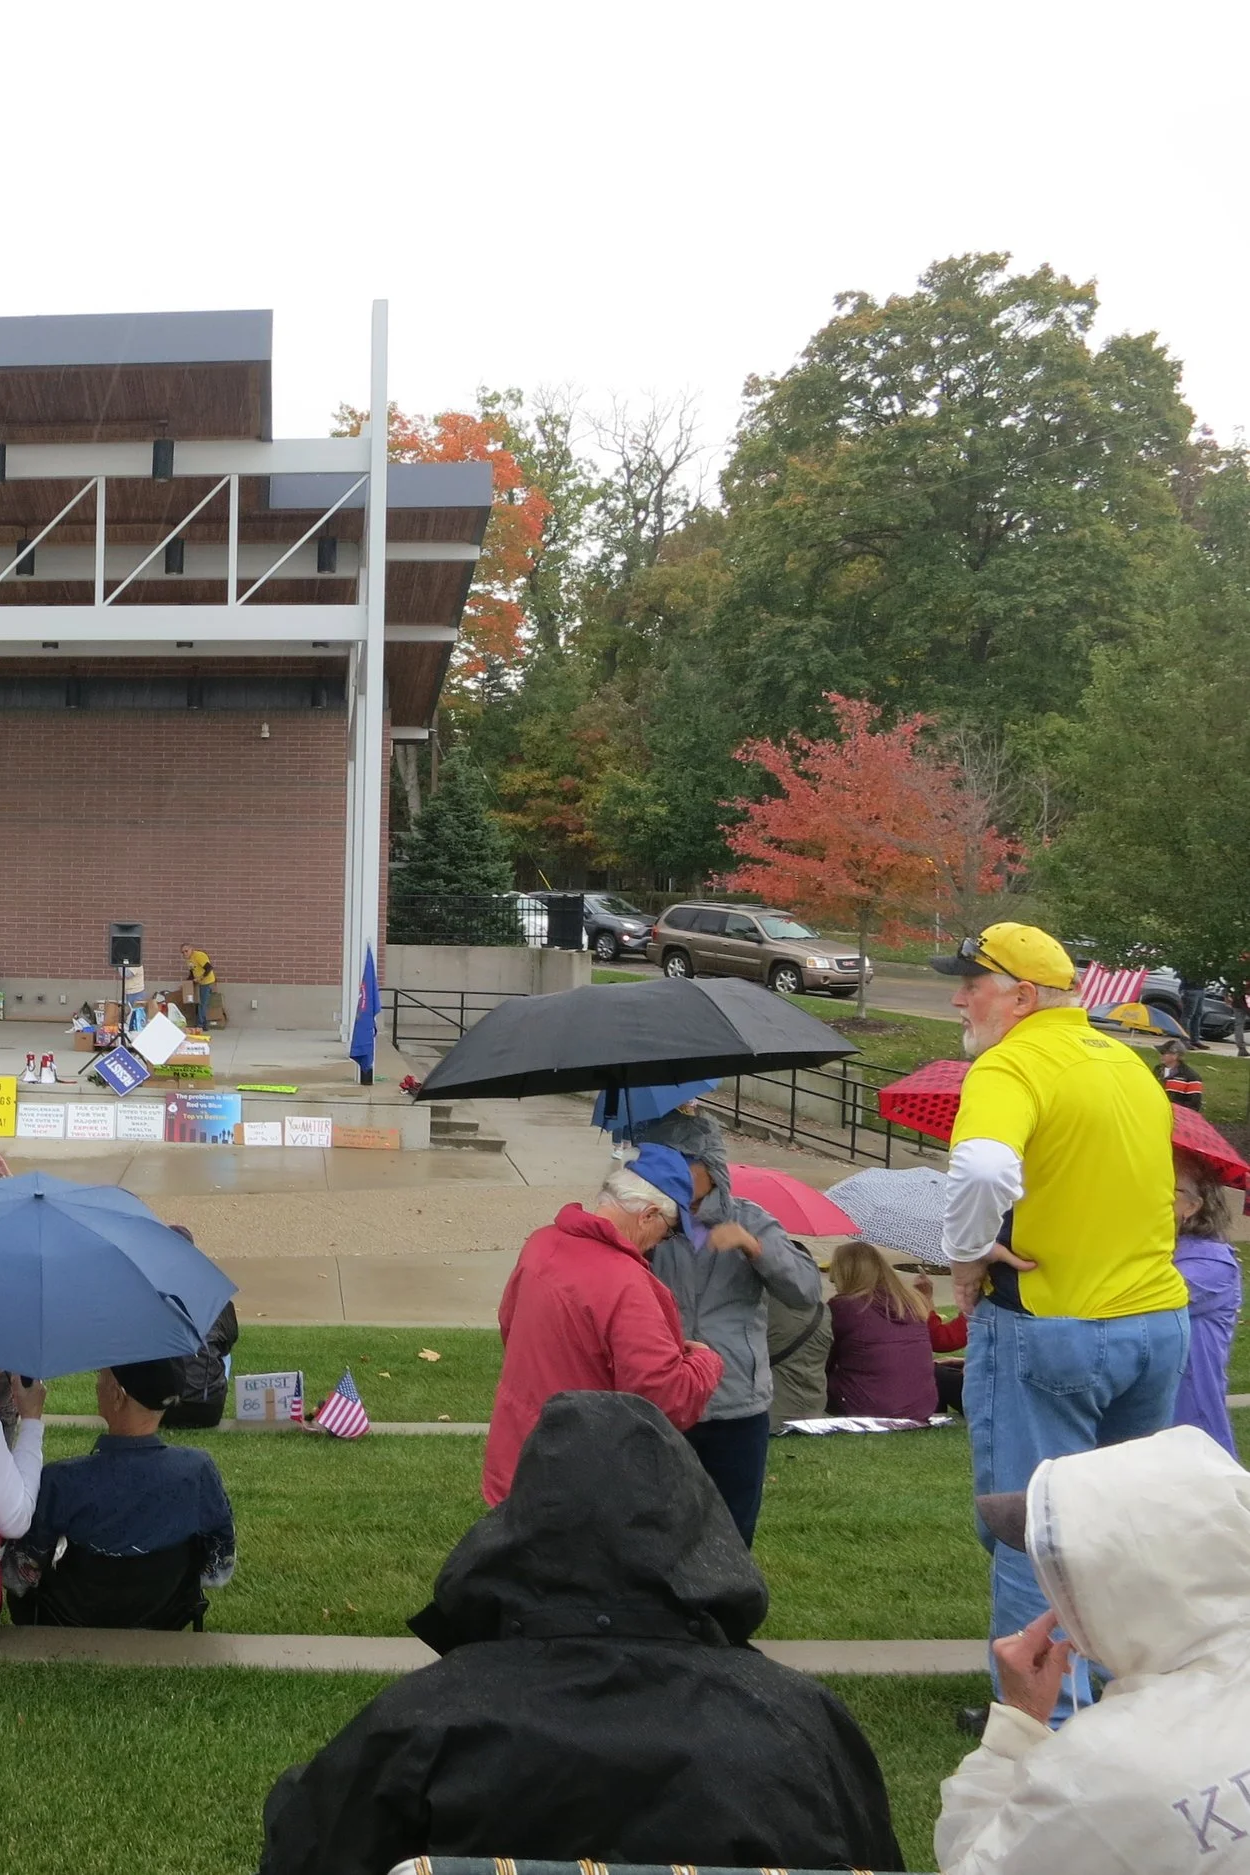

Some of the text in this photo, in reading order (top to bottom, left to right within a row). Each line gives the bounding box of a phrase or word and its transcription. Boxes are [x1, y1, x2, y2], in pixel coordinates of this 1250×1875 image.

[104, 1058, 136, 1088] RESIST!
[301, 1120, 330, 1133] MATTER
[290, 1134, 330, 1146] VOTE!
[245, 1376, 290, 1391] RESIST
[243, 1398, 260, 1411] 86
